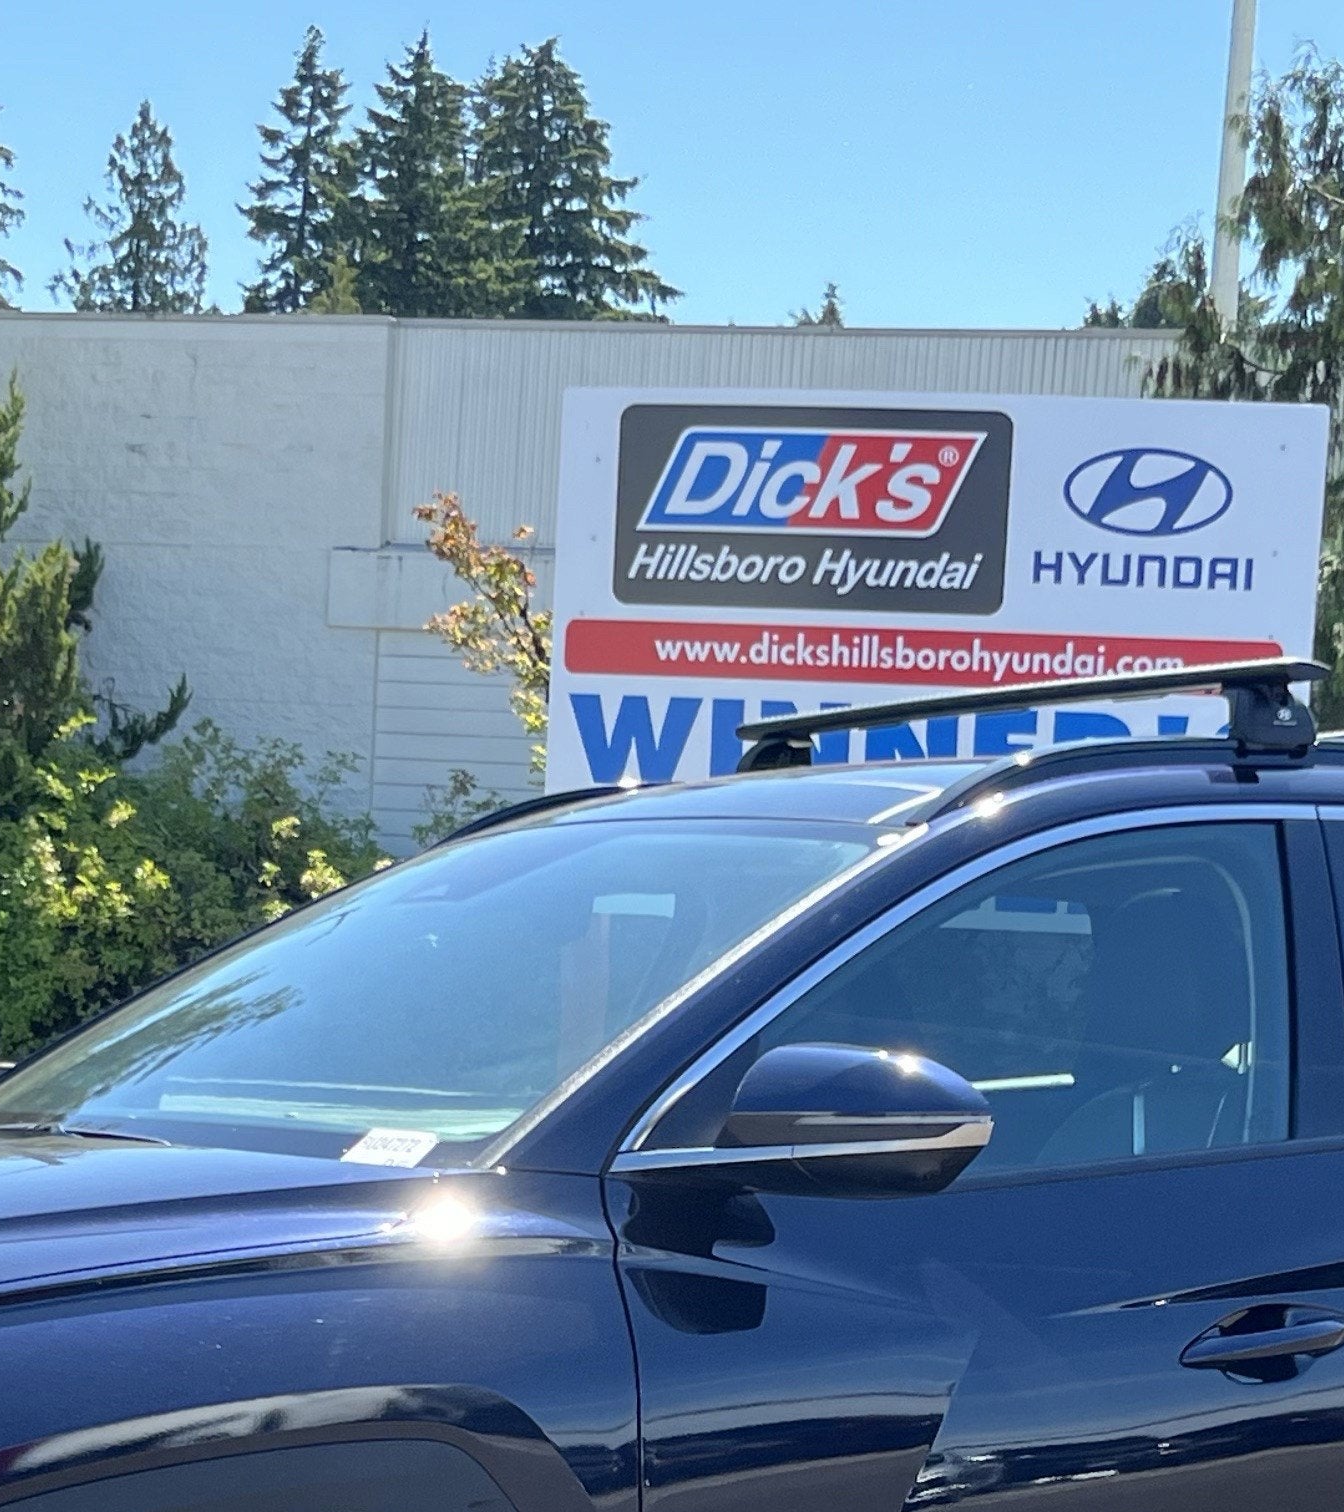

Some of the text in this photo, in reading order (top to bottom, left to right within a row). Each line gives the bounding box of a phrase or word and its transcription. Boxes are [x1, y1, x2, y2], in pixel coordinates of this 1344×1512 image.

[627, 543, 984, 596] Hillsboro Hyundai
[1032, 550, 1254, 591] HYUNDAI
[654, 631, 1185, 682] www.dickshillsborohyundai.com
